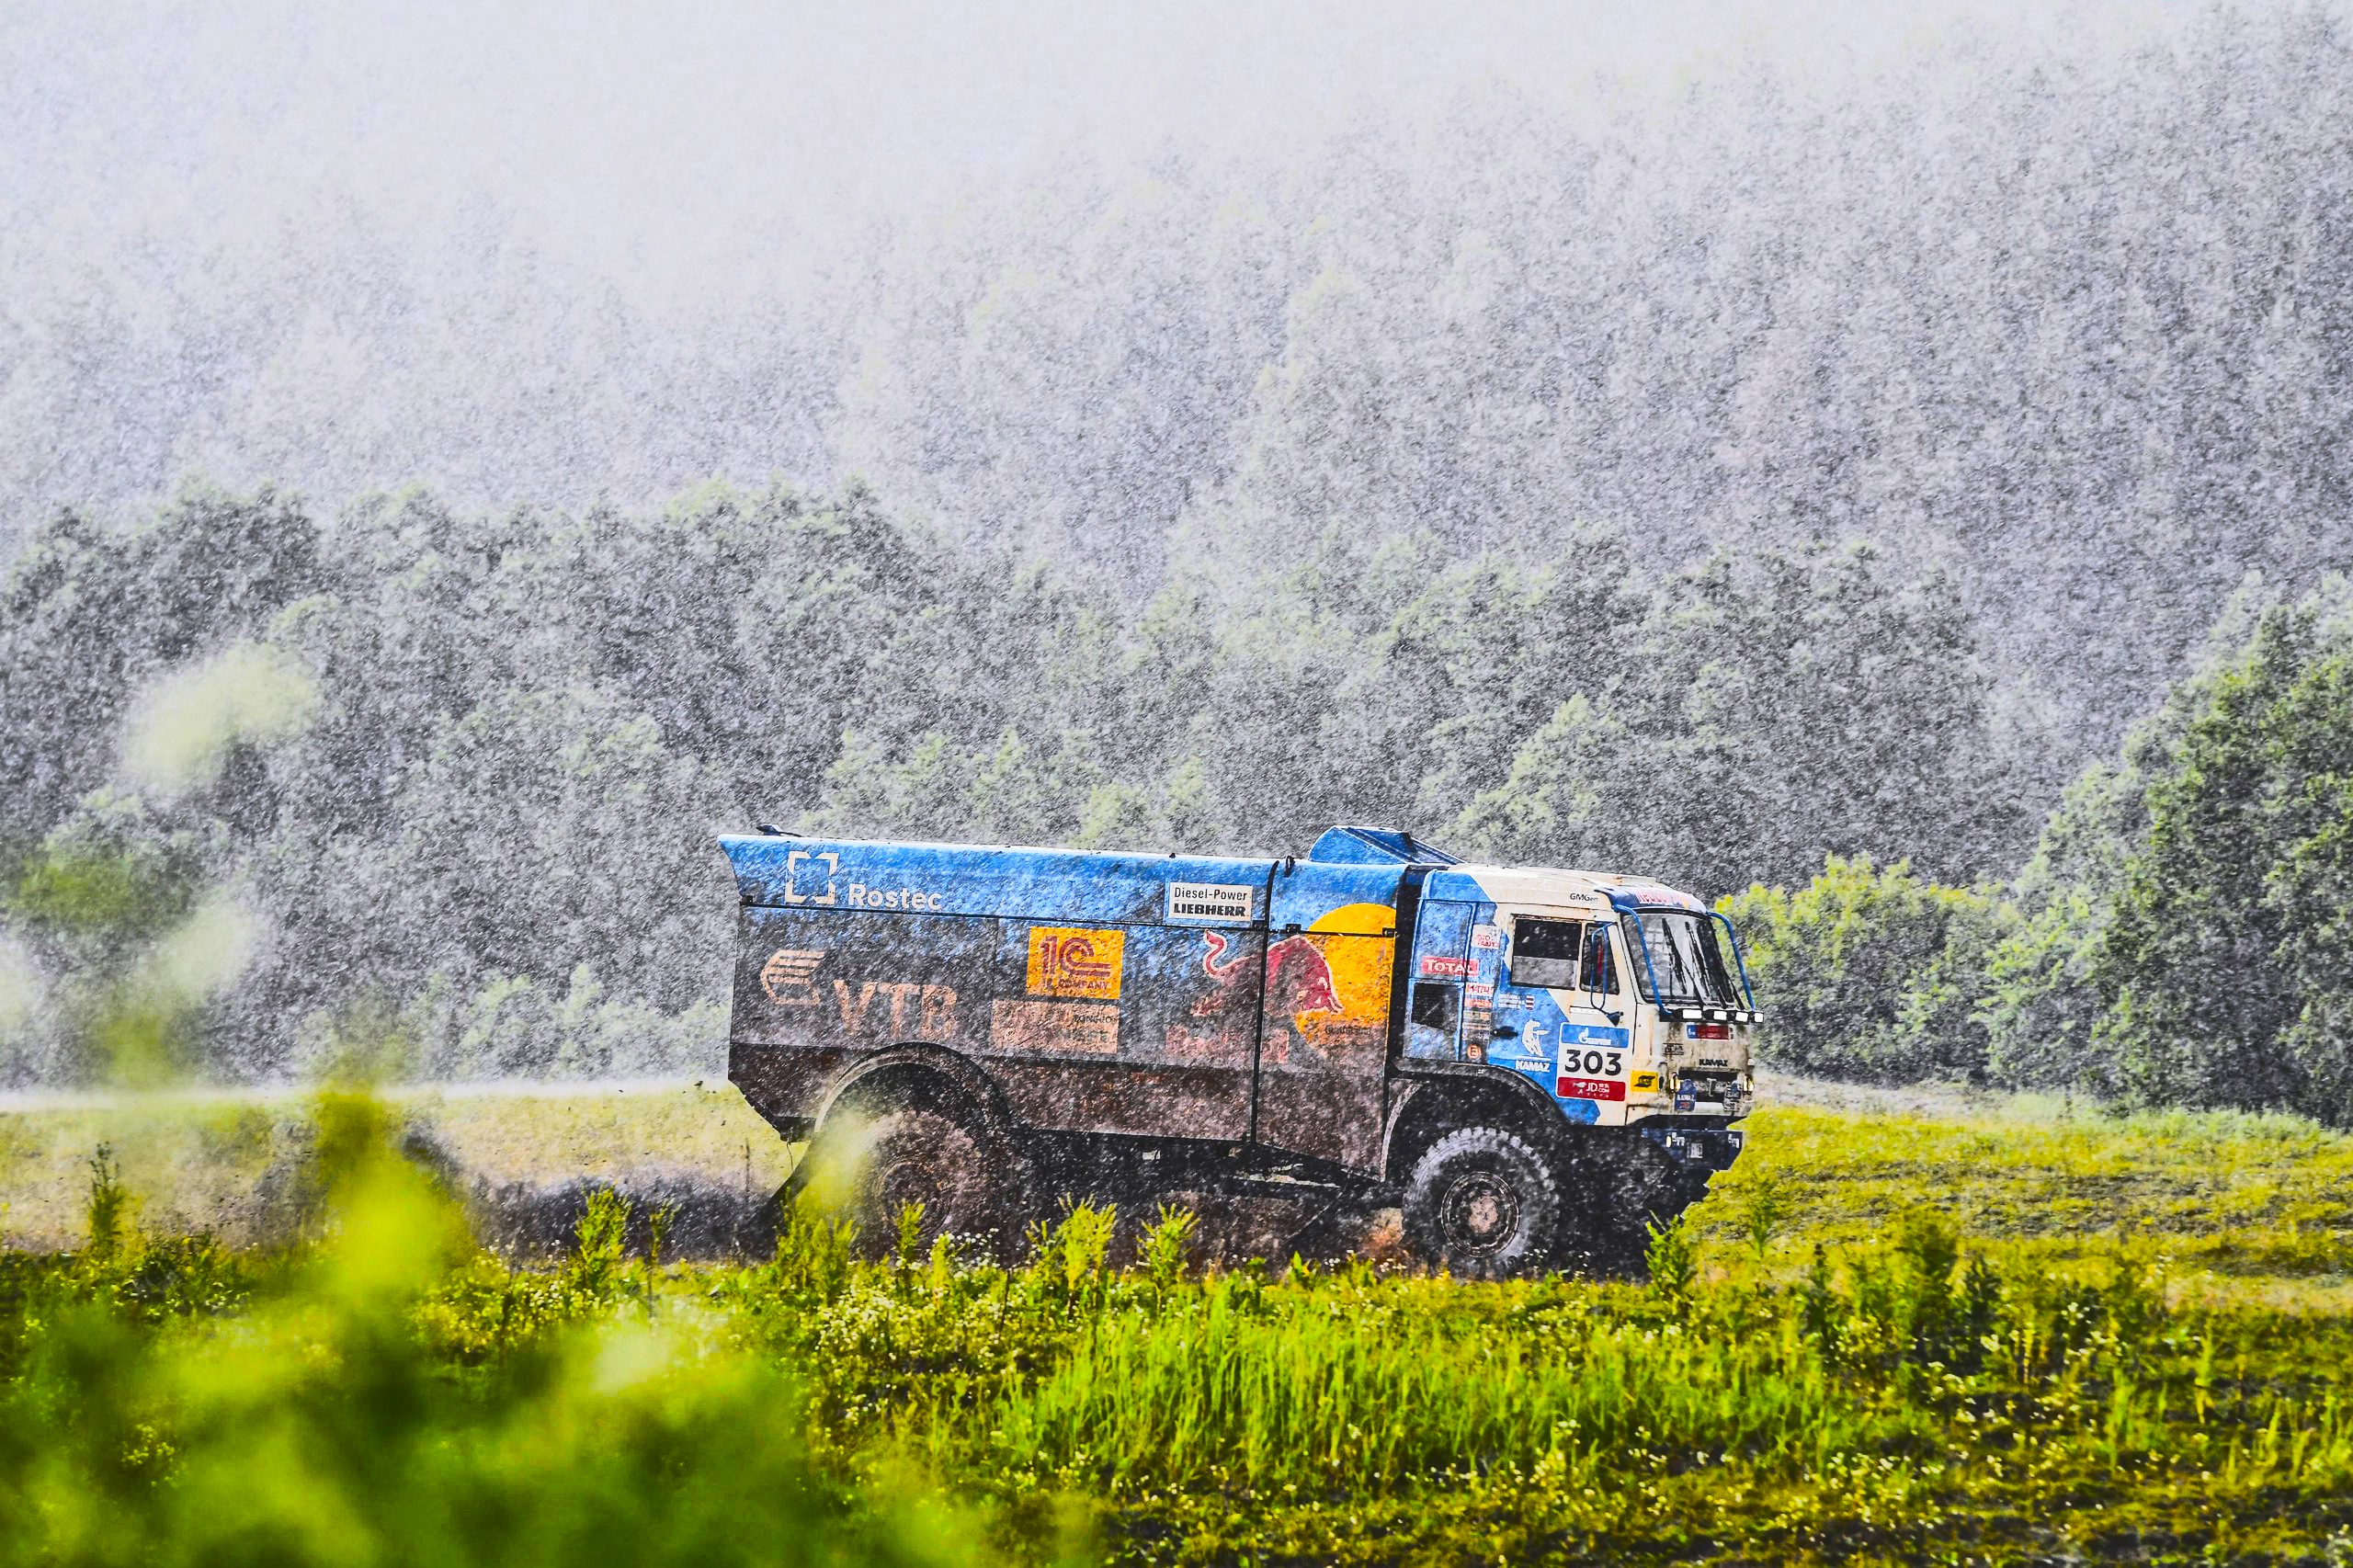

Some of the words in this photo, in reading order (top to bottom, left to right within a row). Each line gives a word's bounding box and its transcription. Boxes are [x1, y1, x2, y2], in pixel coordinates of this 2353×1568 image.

[848, 882, 943, 911] Rostec
[1174, 887, 1248, 901] Diesel-Power
[1569, 892, 1598, 903] GMGen
[1173, 903, 1246, 917] LIEBHERR
[1425, 959, 1477, 974] TOTAL
[833, 979, 958, 1040] VTB
[1515, 1060, 1551, 1073] KAMAZ
[1564, 1049, 1622, 1076] 303
[1586, 1082, 1597, 1092] JD
